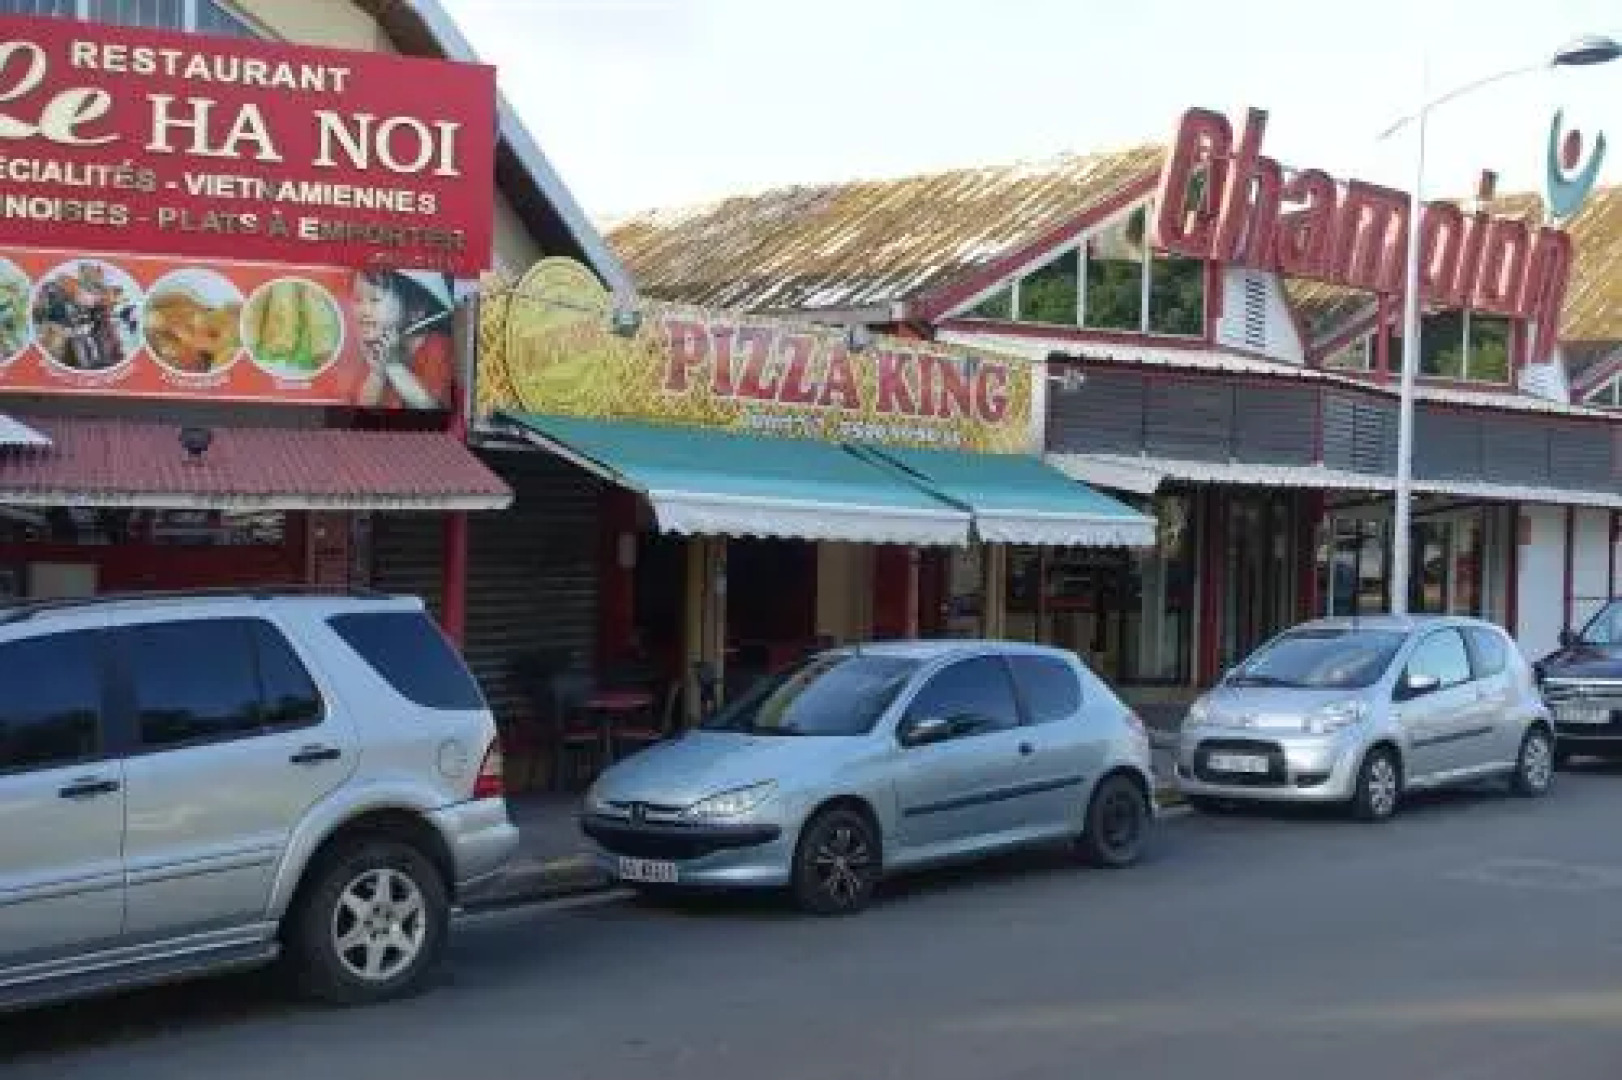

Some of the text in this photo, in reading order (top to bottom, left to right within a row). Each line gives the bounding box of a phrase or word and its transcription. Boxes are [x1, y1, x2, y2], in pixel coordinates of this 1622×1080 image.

[72, 38, 351, 92] RESTAURANT
[145, 93, 283, 162] HA
[311, 109, 461, 176] NOI
[184, 171, 437, 215] VIETNAMIENNES
[158, 207, 257, 234] PLATS
[664, 320, 860, 410] PIZZA
[875, 353, 1008, 423] KING
